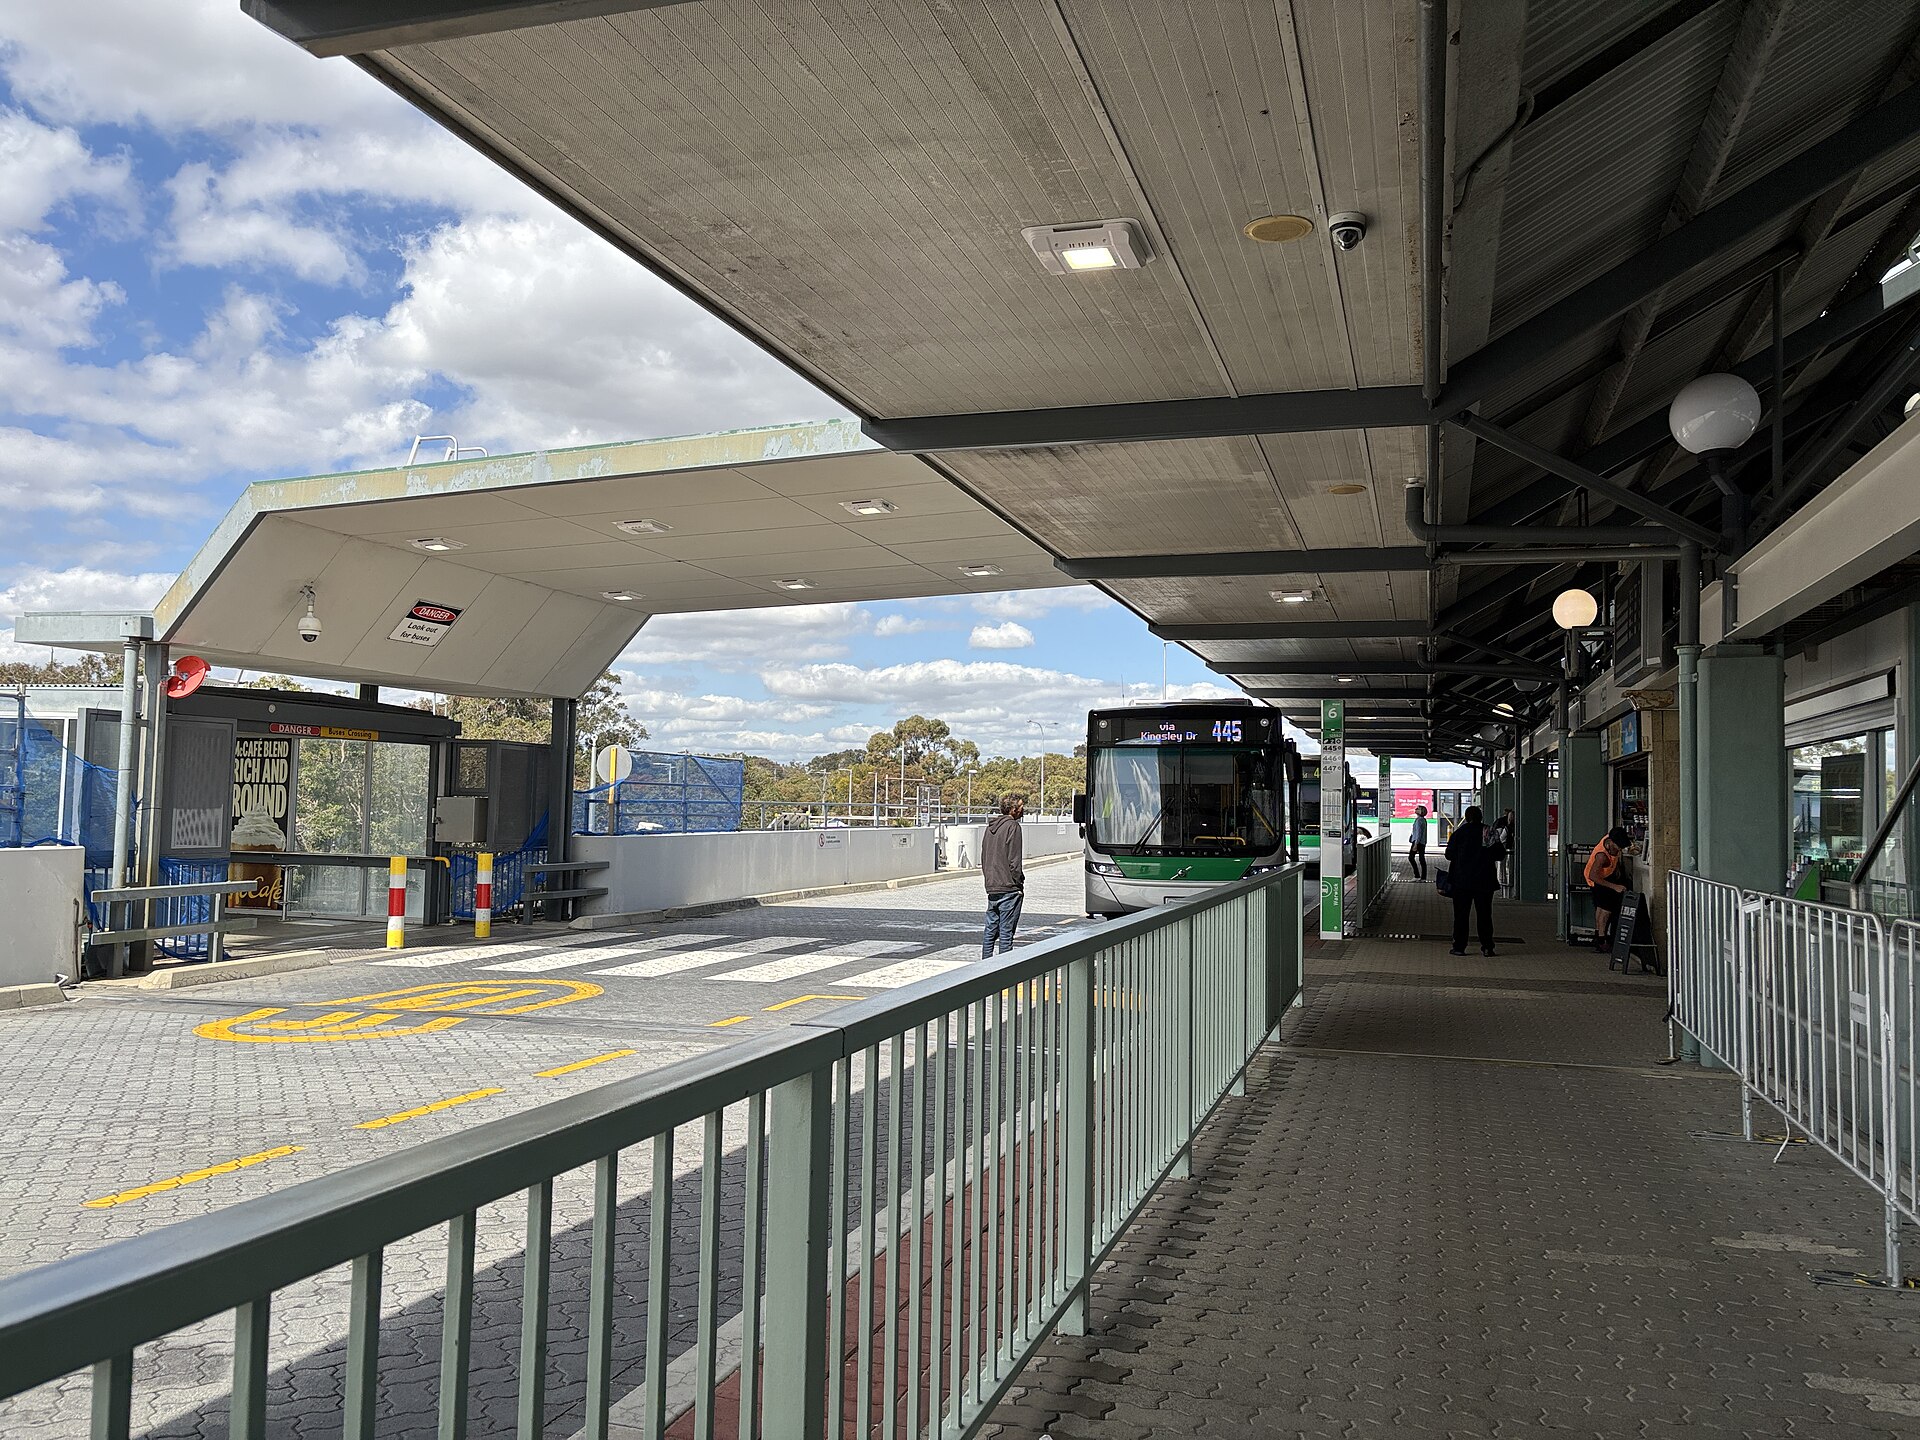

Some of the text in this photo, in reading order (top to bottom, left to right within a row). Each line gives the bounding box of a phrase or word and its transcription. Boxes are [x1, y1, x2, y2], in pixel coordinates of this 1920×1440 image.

[419, 607, 450, 620] DANGER
[407, 621, 426, 631] Look
[400, 630, 431, 642] for buses
[1328, 707, 1338, 719] 6
[278, 724, 312, 735] DANGER
[328, 727, 372, 740] Buses Crossing
[1159, 720, 1242, 743] via 445
[1140, 731, 1198, 743] Kingsley Dr
[263, 740, 289, 758] BLEND
[261, 759, 289, 784] AND
